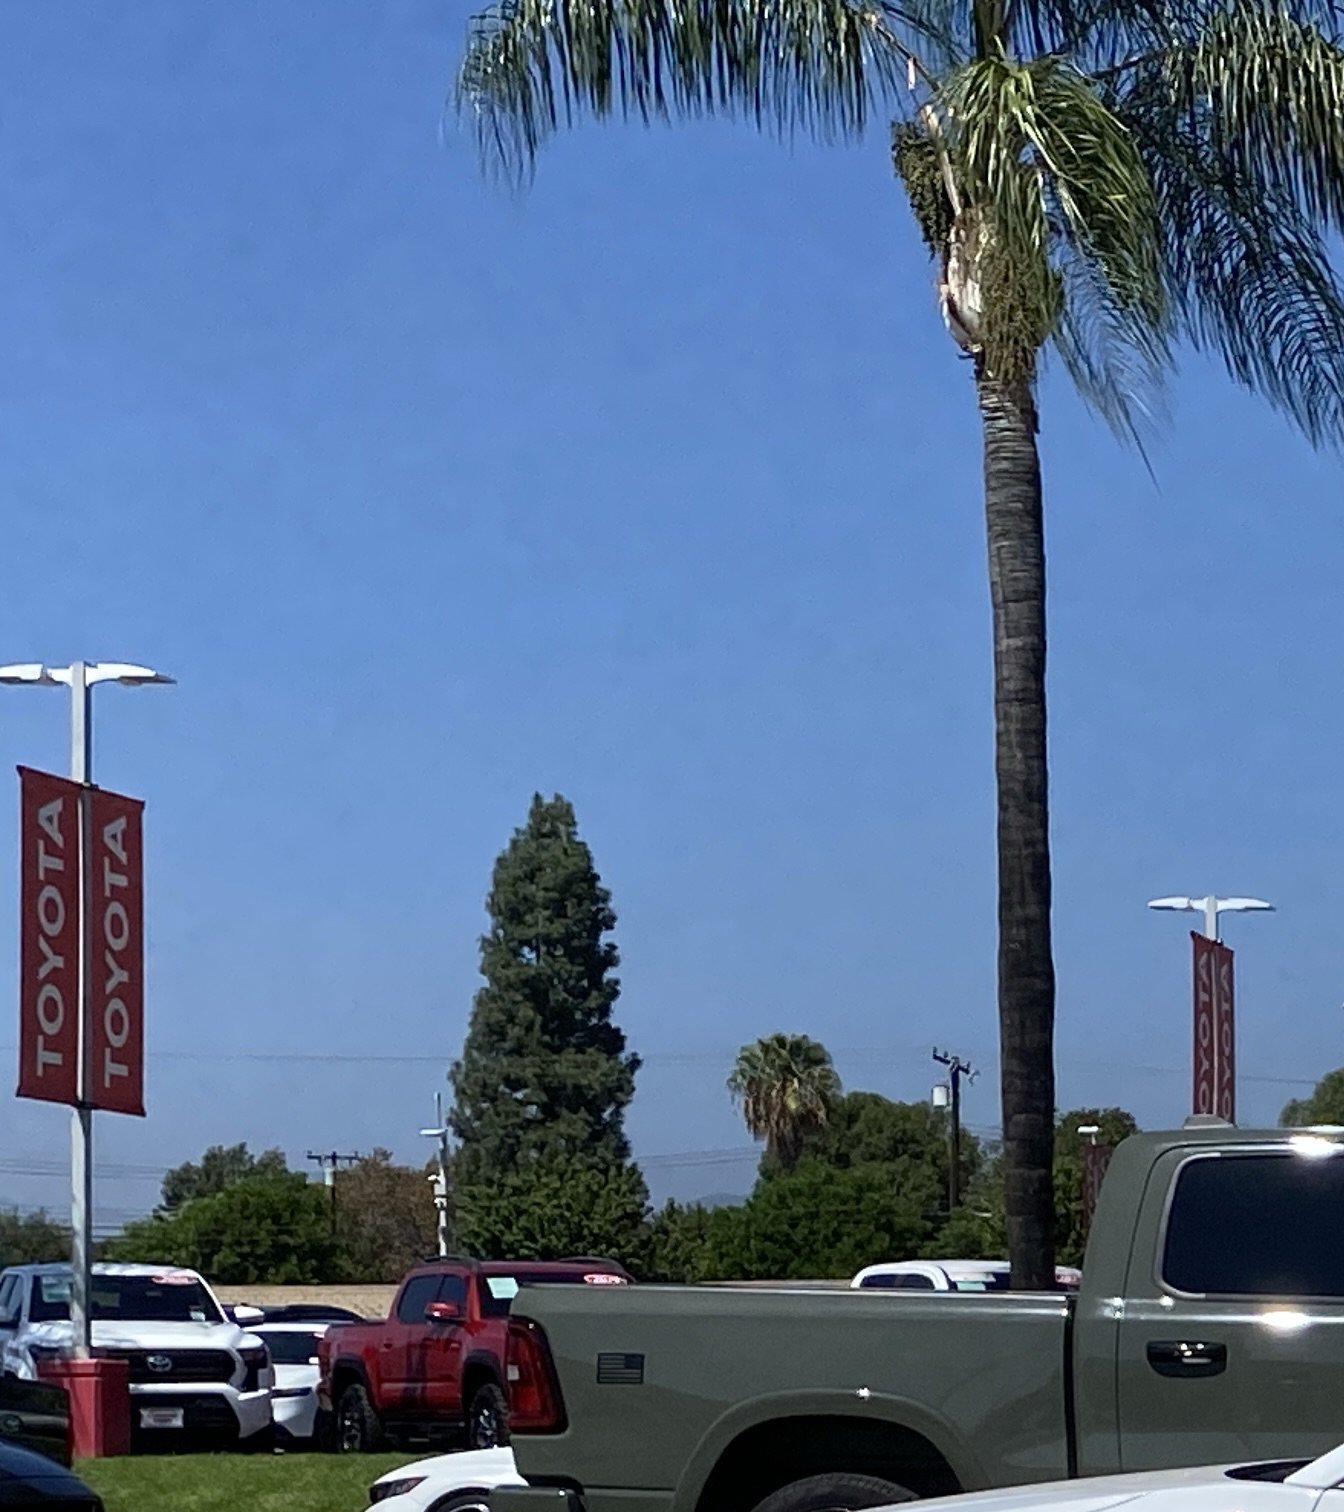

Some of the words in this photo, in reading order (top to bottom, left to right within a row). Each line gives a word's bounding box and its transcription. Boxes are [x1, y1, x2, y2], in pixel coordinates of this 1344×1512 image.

[37, 797, 65, 1077] TOYOTA
[103, 815, 130, 1089] TOYOTA
[1199, 952, 1211, 1115] OYOTA
[1220, 963, 1232, 1121] OYOTA
